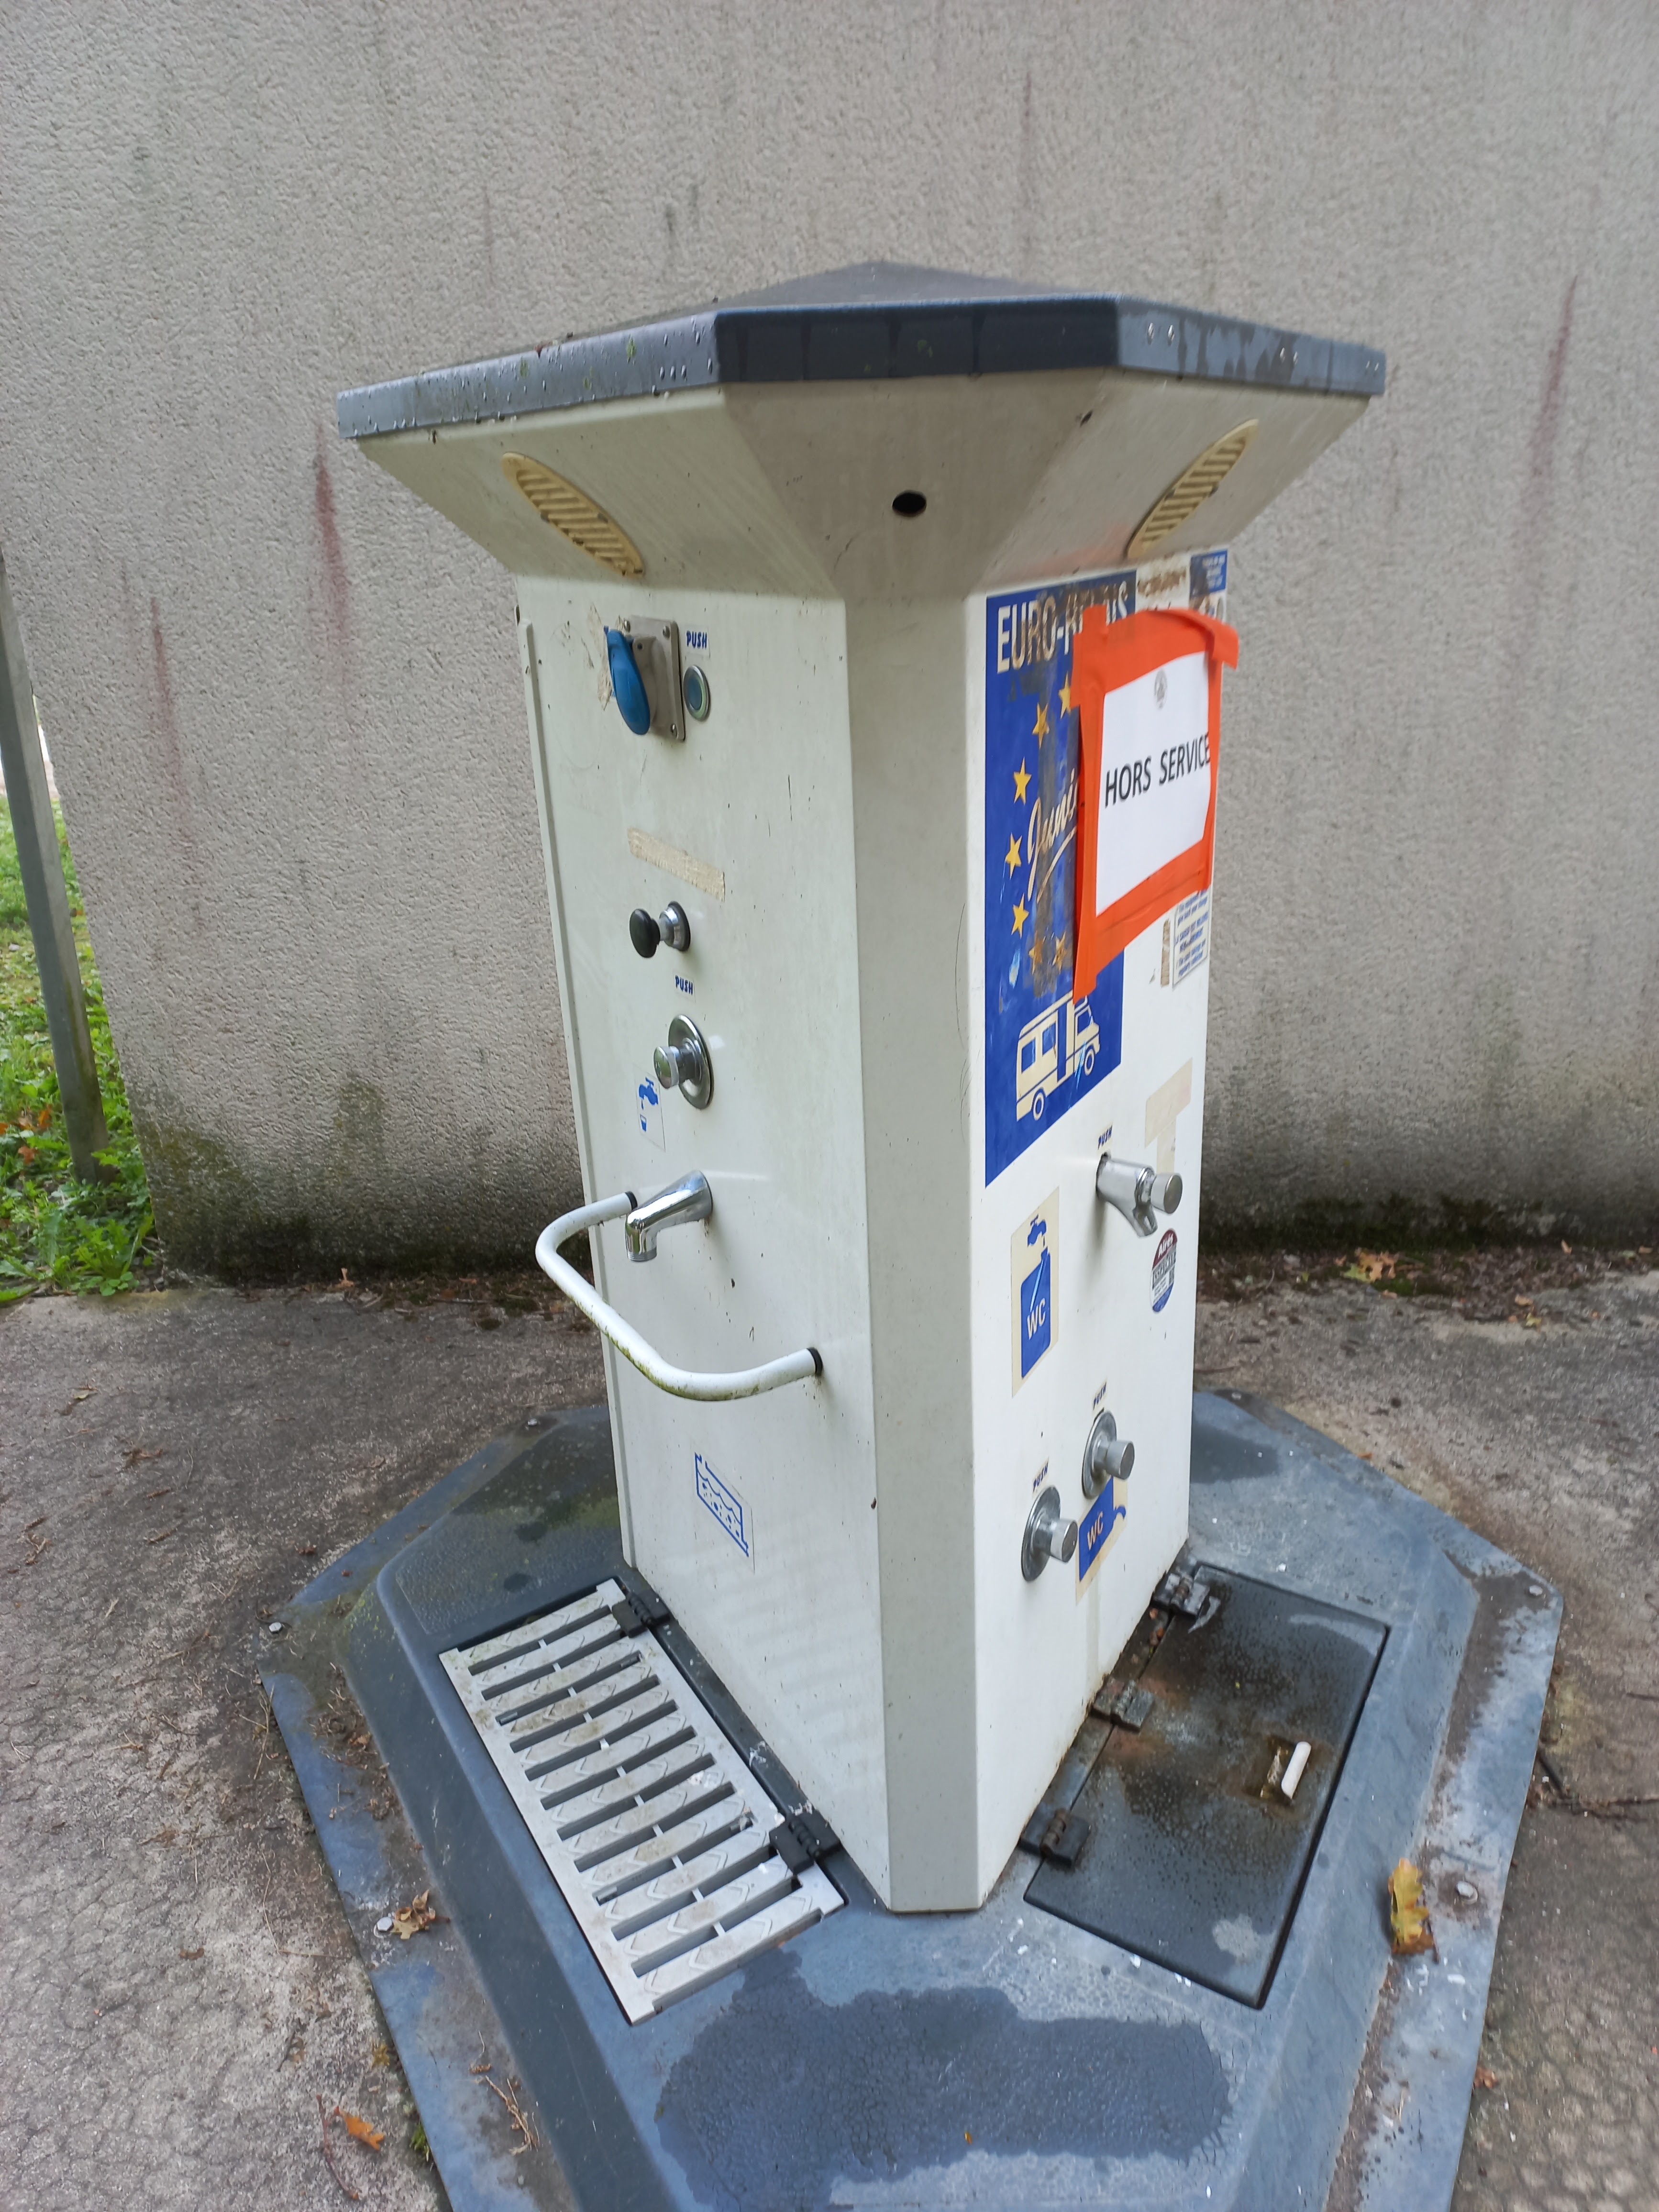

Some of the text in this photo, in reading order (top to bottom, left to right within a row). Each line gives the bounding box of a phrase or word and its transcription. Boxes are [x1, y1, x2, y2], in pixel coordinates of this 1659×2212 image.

[686, 630, 707, 650] PUSH
[1105, 731, 1211, 808] HORS SERVICE
[675, 974, 693, 996] PUSH
[1097, 1125, 1113, 1150] PUSH
[1027, 1297, 1046, 1340] WC
[1093, 1381, 1107, 1411] PUSH
[1033, 1461, 1048, 1493] PUSH
[1087, 1511, 1104, 1550] WC
